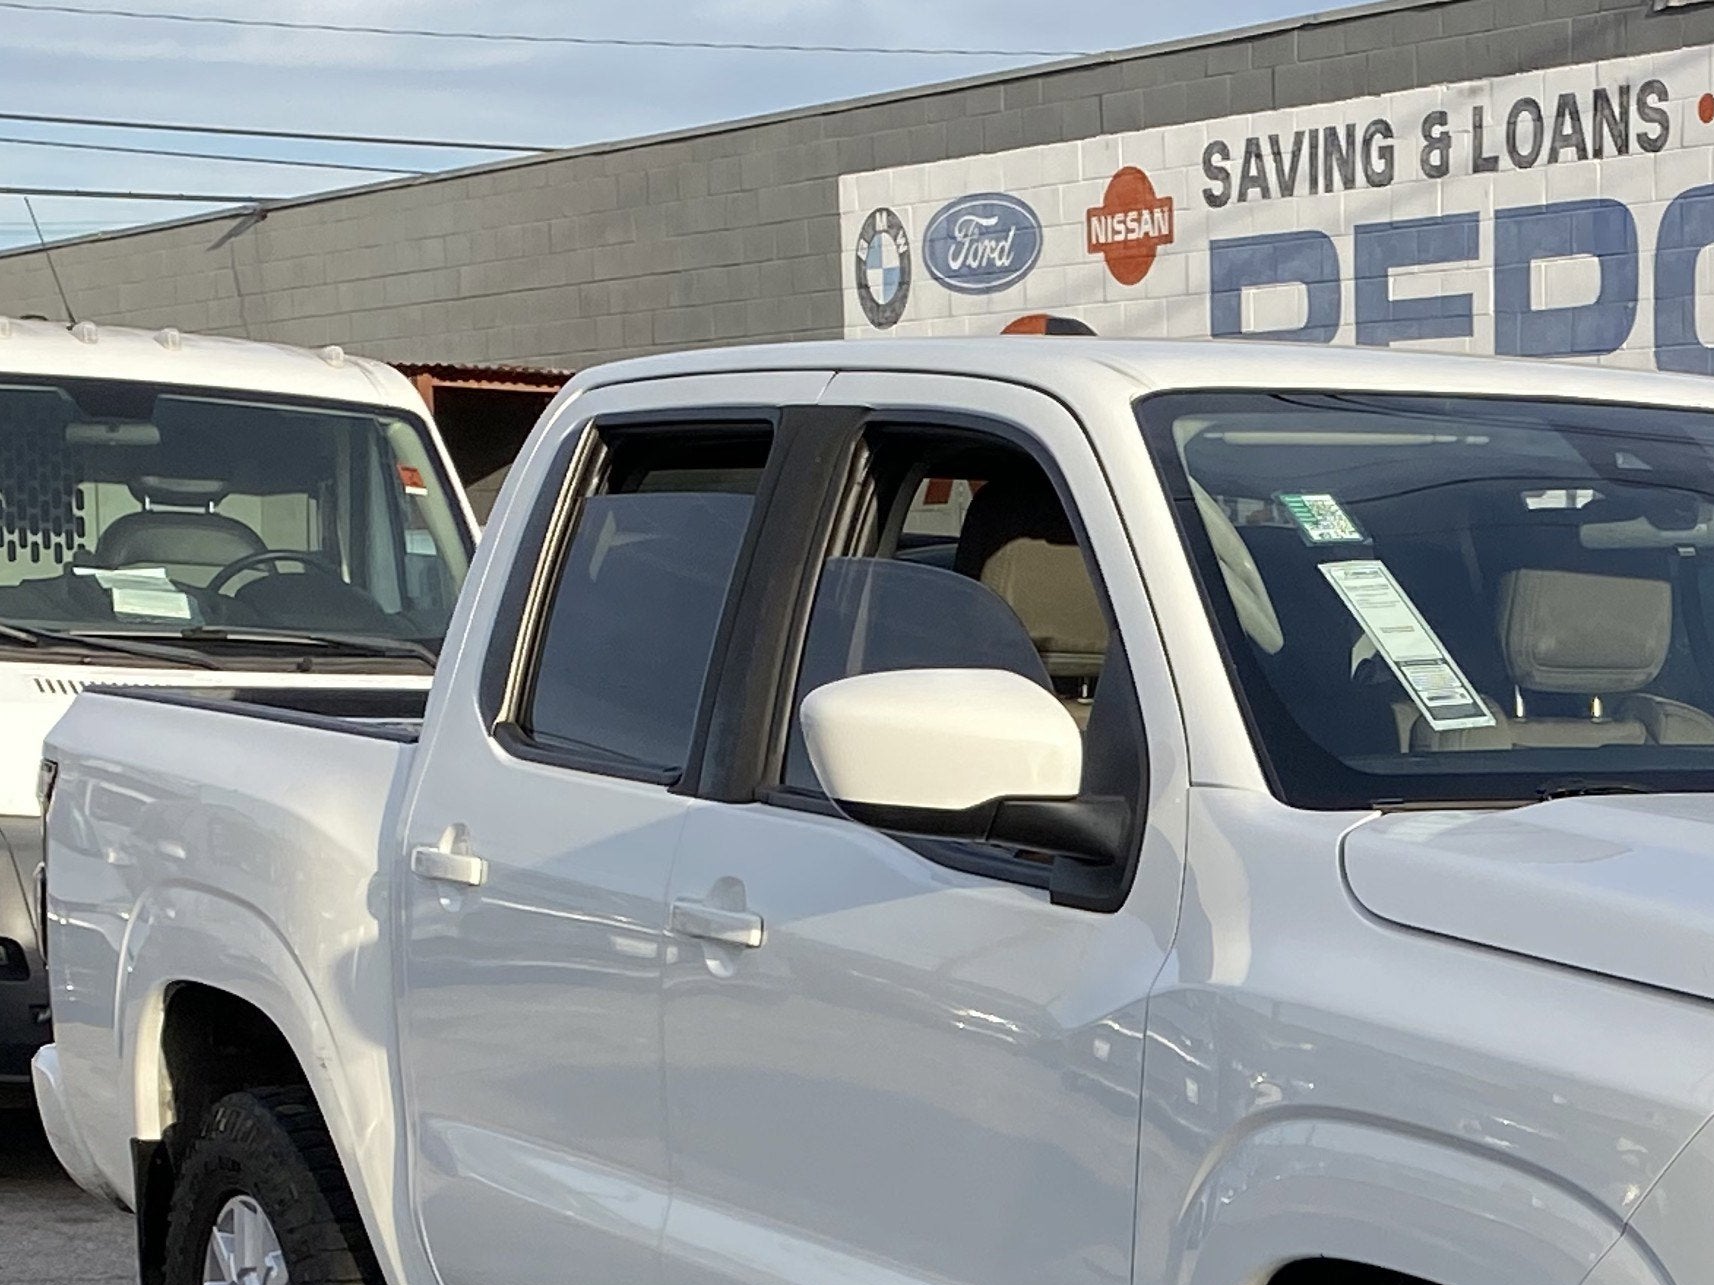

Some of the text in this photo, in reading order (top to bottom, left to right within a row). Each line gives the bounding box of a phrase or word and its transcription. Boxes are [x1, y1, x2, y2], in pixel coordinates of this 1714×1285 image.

[1203, 118, 1396, 208] SAVING
[1420, 110, 1452, 178] &
[1472, 79, 1670, 173] LOANS
[949, 214, 1016, 270] Ford
[1090, 207, 1170, 244] NISSAN
